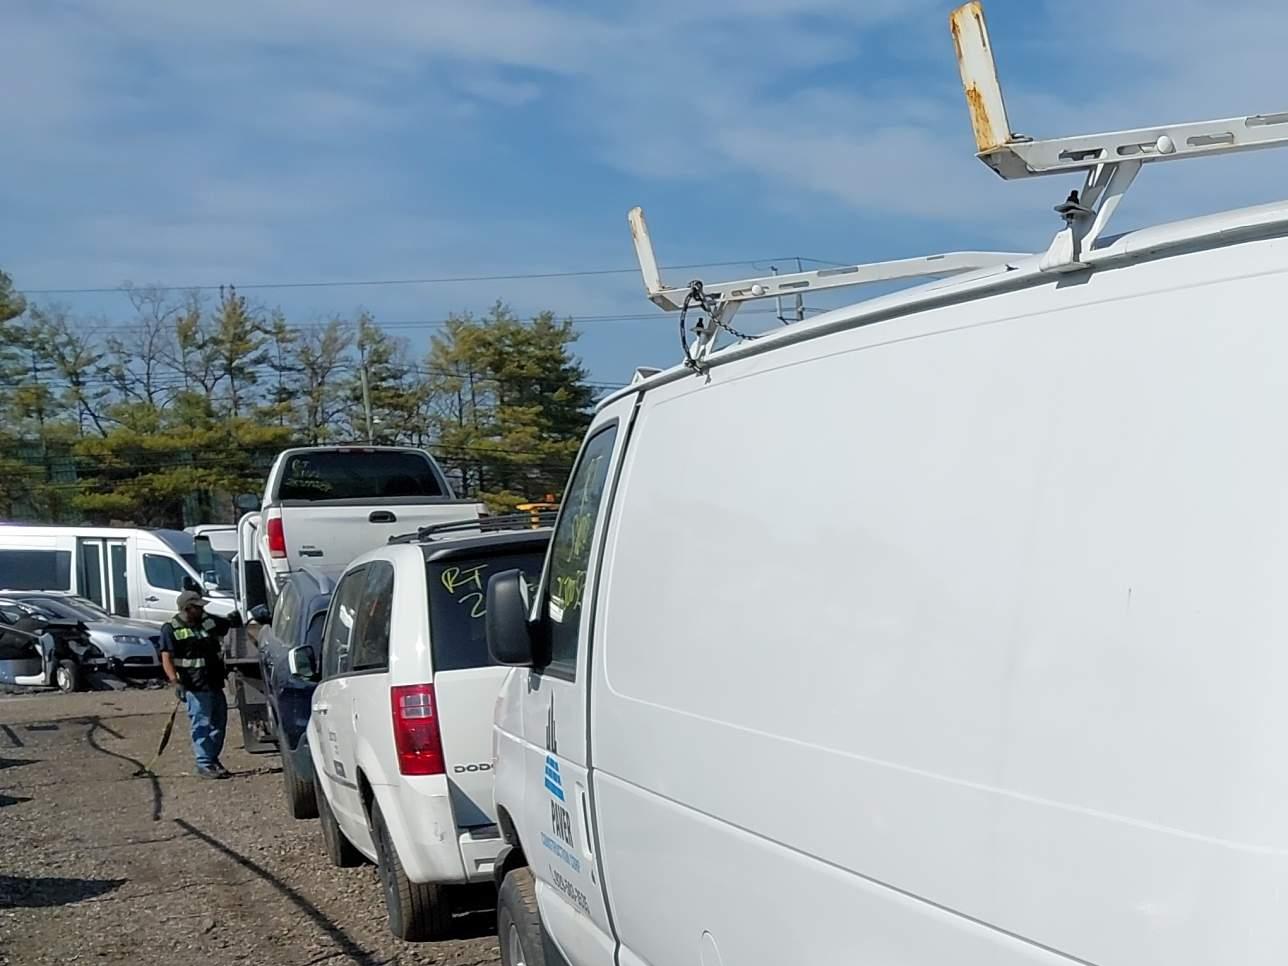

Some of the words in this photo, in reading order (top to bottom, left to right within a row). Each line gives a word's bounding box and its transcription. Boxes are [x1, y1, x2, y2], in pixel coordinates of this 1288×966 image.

[441, 564, 488, 594] RT
[454, 763, 494, 774] DOD
[551, 799, 574, 849] PAVER
